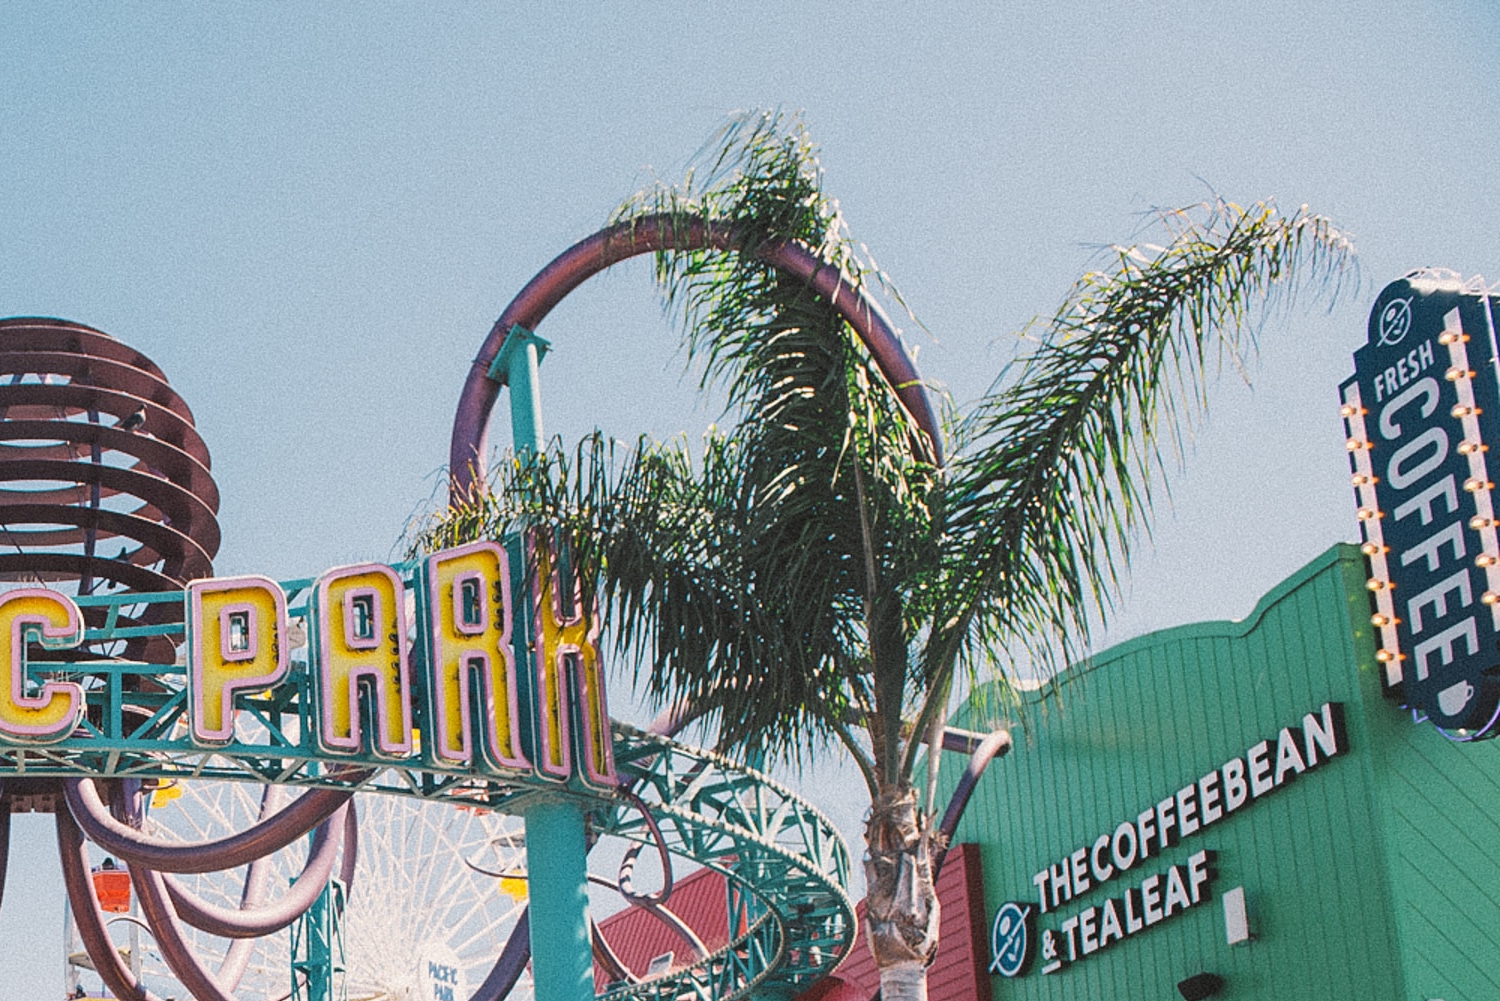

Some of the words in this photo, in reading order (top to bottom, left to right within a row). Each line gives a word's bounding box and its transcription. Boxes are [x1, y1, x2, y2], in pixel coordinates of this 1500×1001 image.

[1373, 339, 1434, 402] FRESH
[1379, 377, 1479, 682] COFFEE
[185, 525, 618, 789] PARK
[428, 960, 459, 986] PACIFIC
[1041, 928, 1061, 970] &
